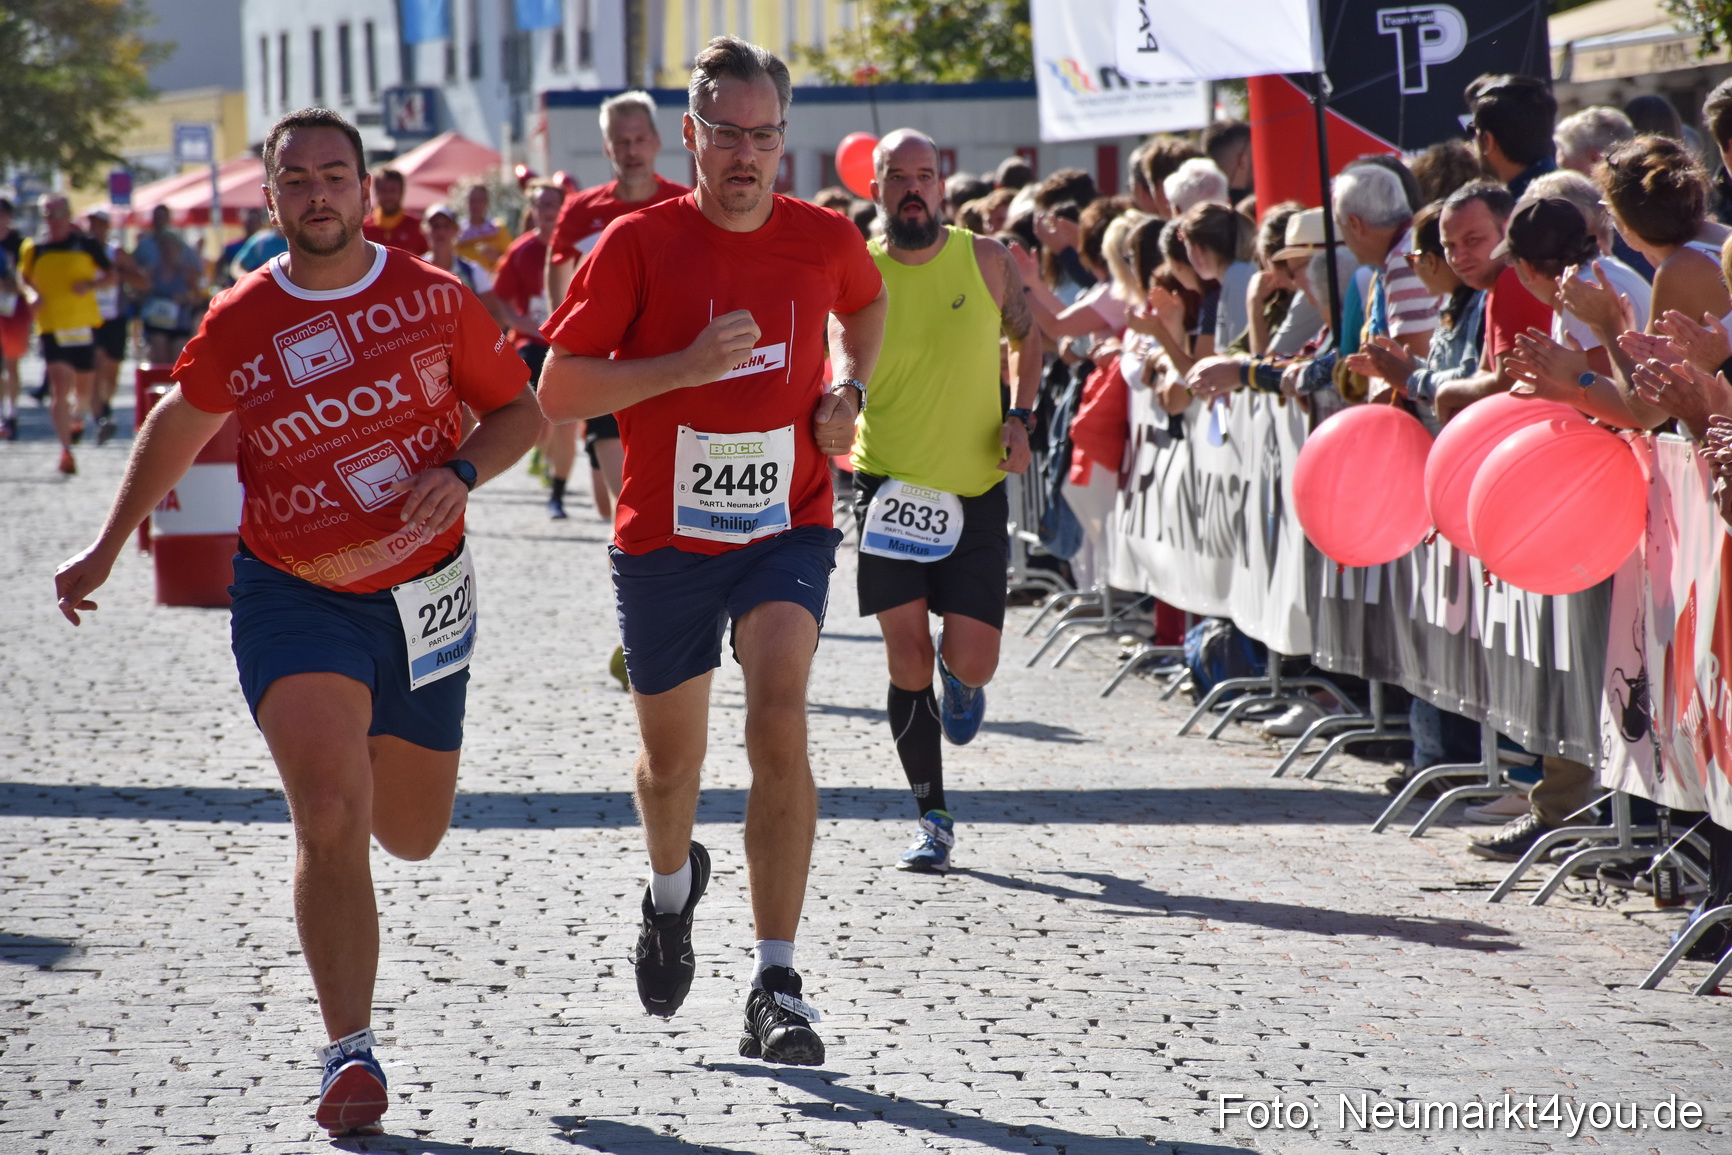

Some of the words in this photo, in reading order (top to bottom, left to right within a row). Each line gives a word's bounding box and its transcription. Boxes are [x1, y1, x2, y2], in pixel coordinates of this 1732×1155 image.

[278, 318, 333, 348] raumbox
[363, 327, 430, 360] schenken
[295, 434, 351, 464] wohnen
[361, 407, 416, 436] outdoor
[709, 442, 764, 455] BOCK
[340, 445, 396, 475] raumbox
[692, 462, 778, 496] 2448
[901, 484, 942, 502] BOCK
[699, 499, 725, 508] PARTL
[726, 501, 763, 509] Neumarkt
[881, 498, 949, 535] 2633
[884, 526, 904, 536] PARTL
[905, 530, 932, 542] Neumarkt
[888, 538, 930, 556] Markus
[418, 574, 472, 639] 2222
[428, 633, 450, 648] PARTL
